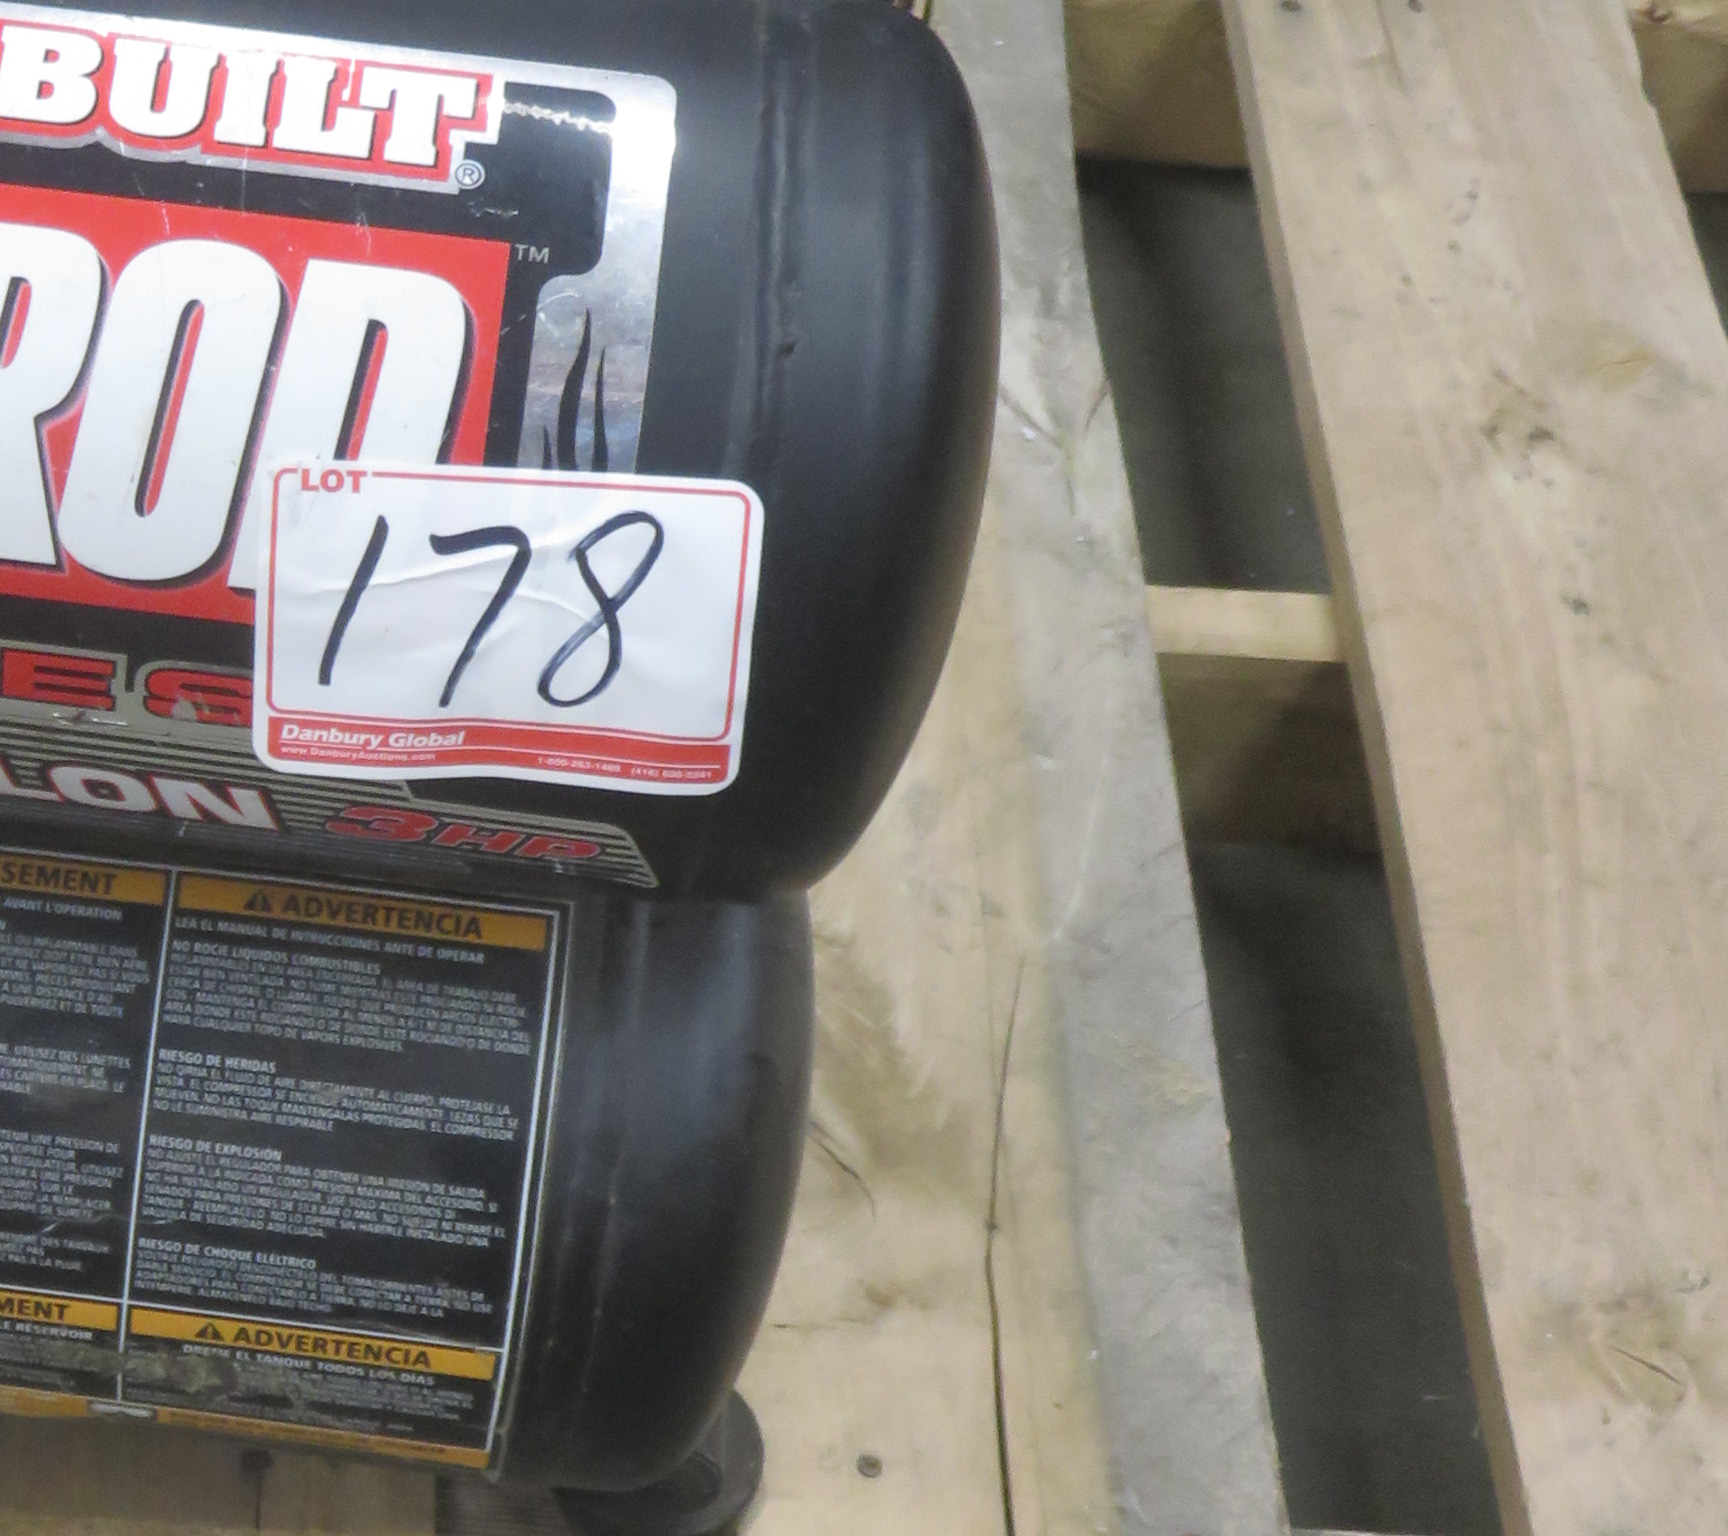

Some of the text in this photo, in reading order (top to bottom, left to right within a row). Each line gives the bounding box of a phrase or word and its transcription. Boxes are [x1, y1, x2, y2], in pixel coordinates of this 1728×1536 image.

[300, 468, 368, 495] LOT
[317, 510, 667, 708] 178
[281, 724, 466, 751] Danbury Global
[281, 893, 486, 940] ADVERTENCIA
[172, 938, 191, 952] NO
[232, 946, 288, 964] LIQUIDOS
[291, 953, 380, 975] COMBUSTIBLES
[158, 1048, 277, 1074] RIESGO DE HERIDAS
[148, 1134, 193, 1150] RIESGO
[195, 1139, 212, 1153] DE
[137, 1236, 182, 1253] RIESGO
[183, 1242, 199, 1255] DE
[203, 1244, 253, 1261] CHOQUE
[232, 1326, 432, 1369] ADVERTENCIA
[256, 1352, 312, 1370] TANQUE
[317, 1360, 366, 1377] TODOS
[369, 1367, 397, 1381] LOS
